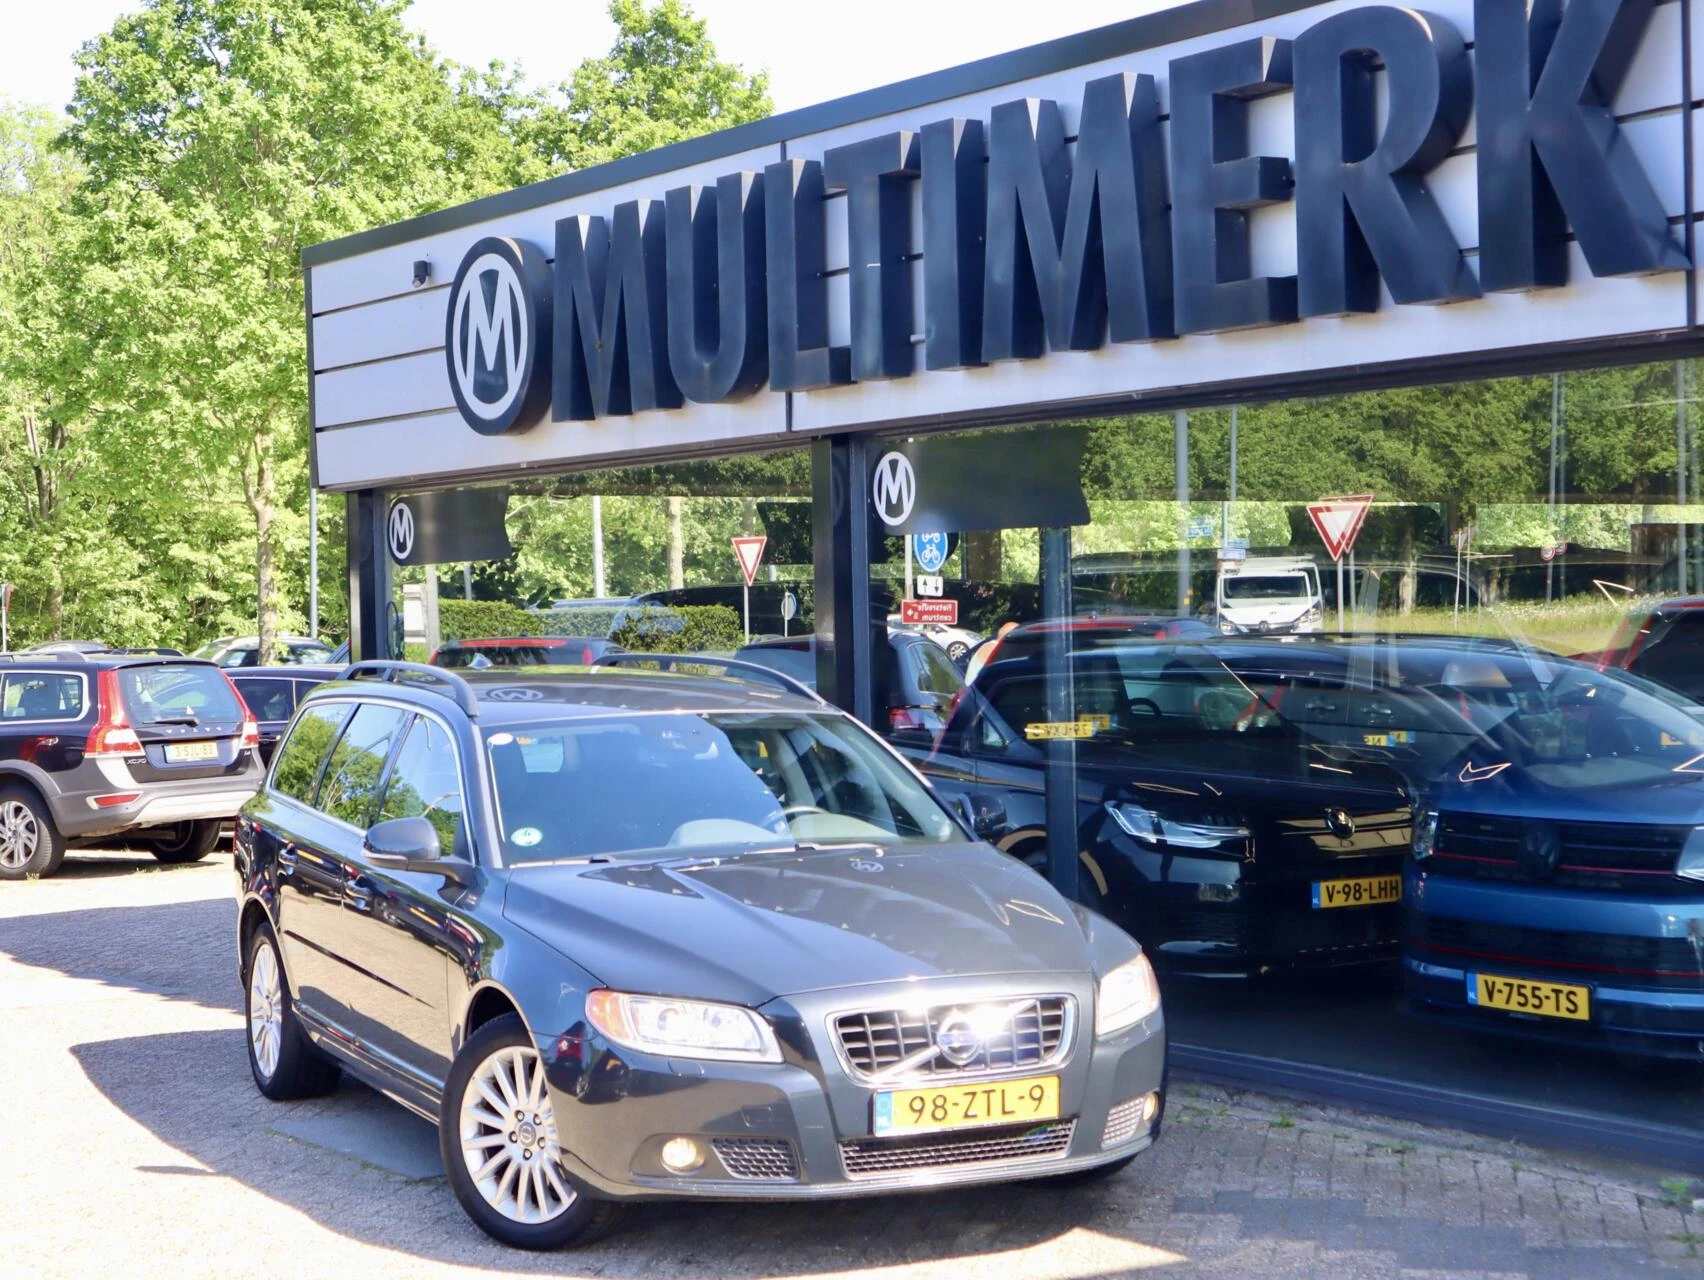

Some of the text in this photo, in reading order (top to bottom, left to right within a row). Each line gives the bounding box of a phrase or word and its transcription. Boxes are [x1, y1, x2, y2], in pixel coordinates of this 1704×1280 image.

[551, 0, 1692, 422] MULTIMERK
[1326, 880, 1399, 903] V-98-LHH
[1484, 979, 1579, 1014] V-755-TS
[908, 1084, 1045, 1125] 98-ZTL-9
